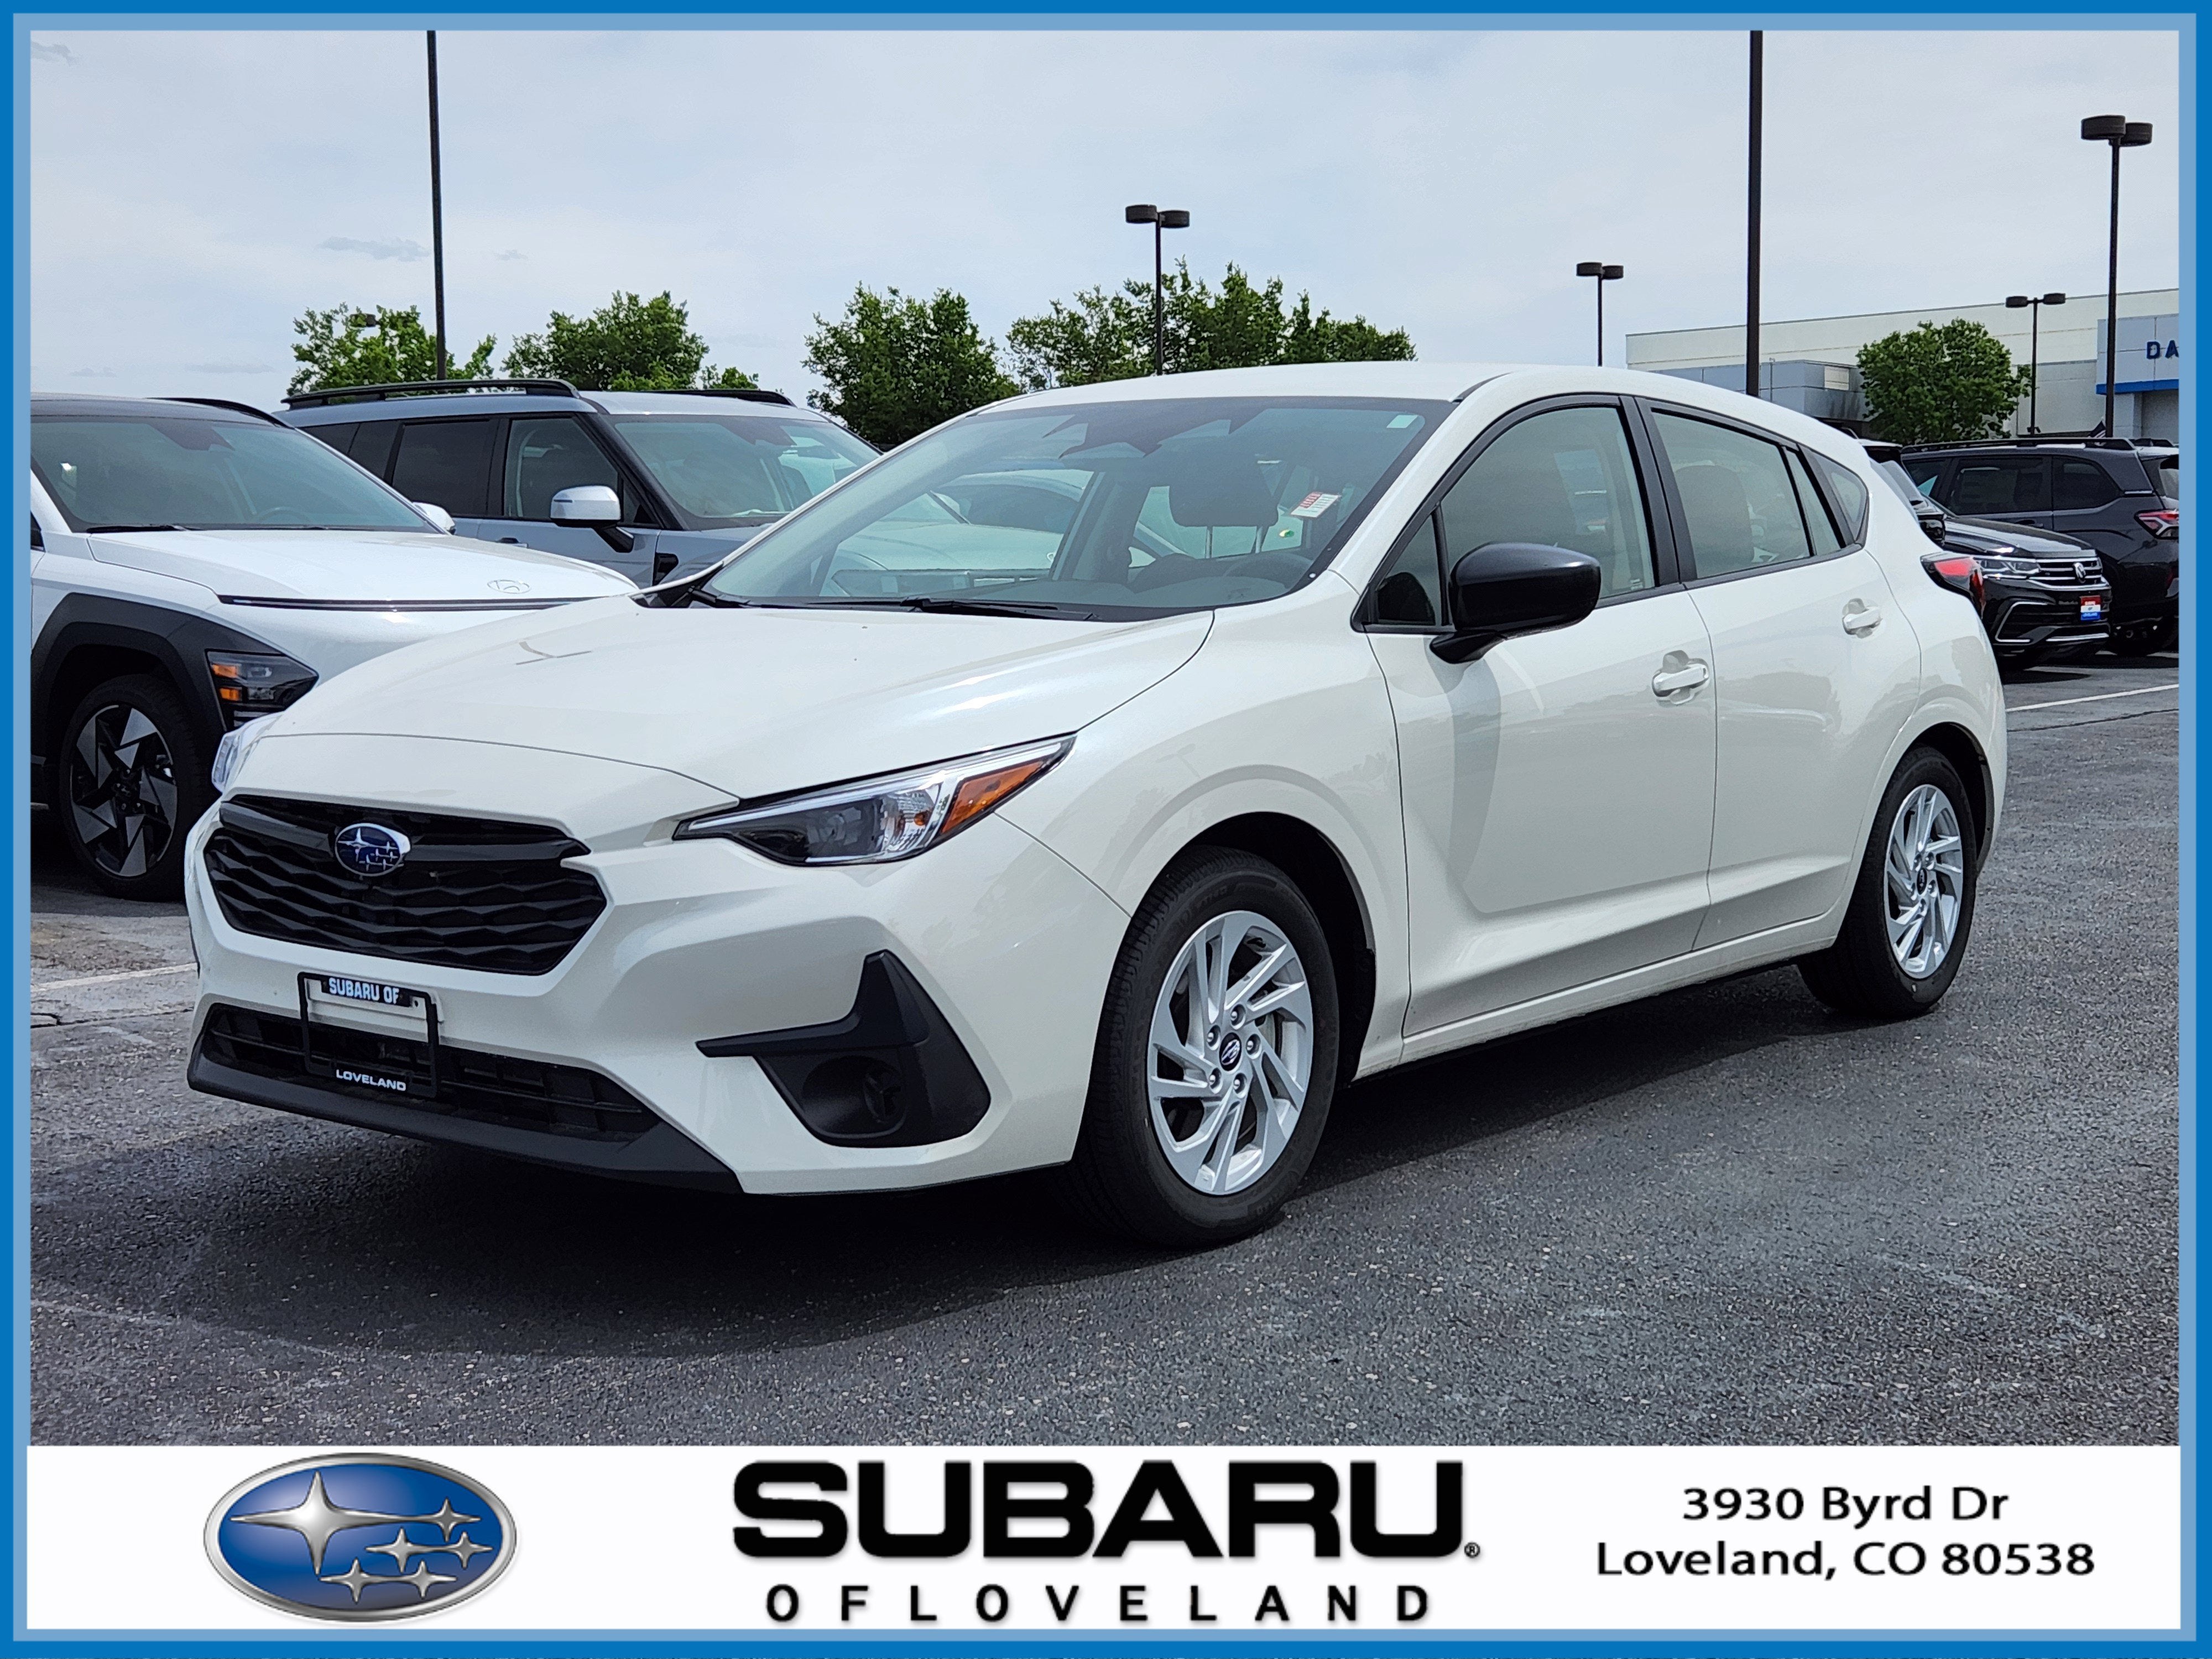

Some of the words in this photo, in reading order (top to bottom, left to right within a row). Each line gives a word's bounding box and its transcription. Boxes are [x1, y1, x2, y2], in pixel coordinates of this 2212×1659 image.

[328, 977, 380, 1001] SUBARU
[383, 986, 400, 1004] OF
[336, 1069, 406, 1092] LOVELAND
